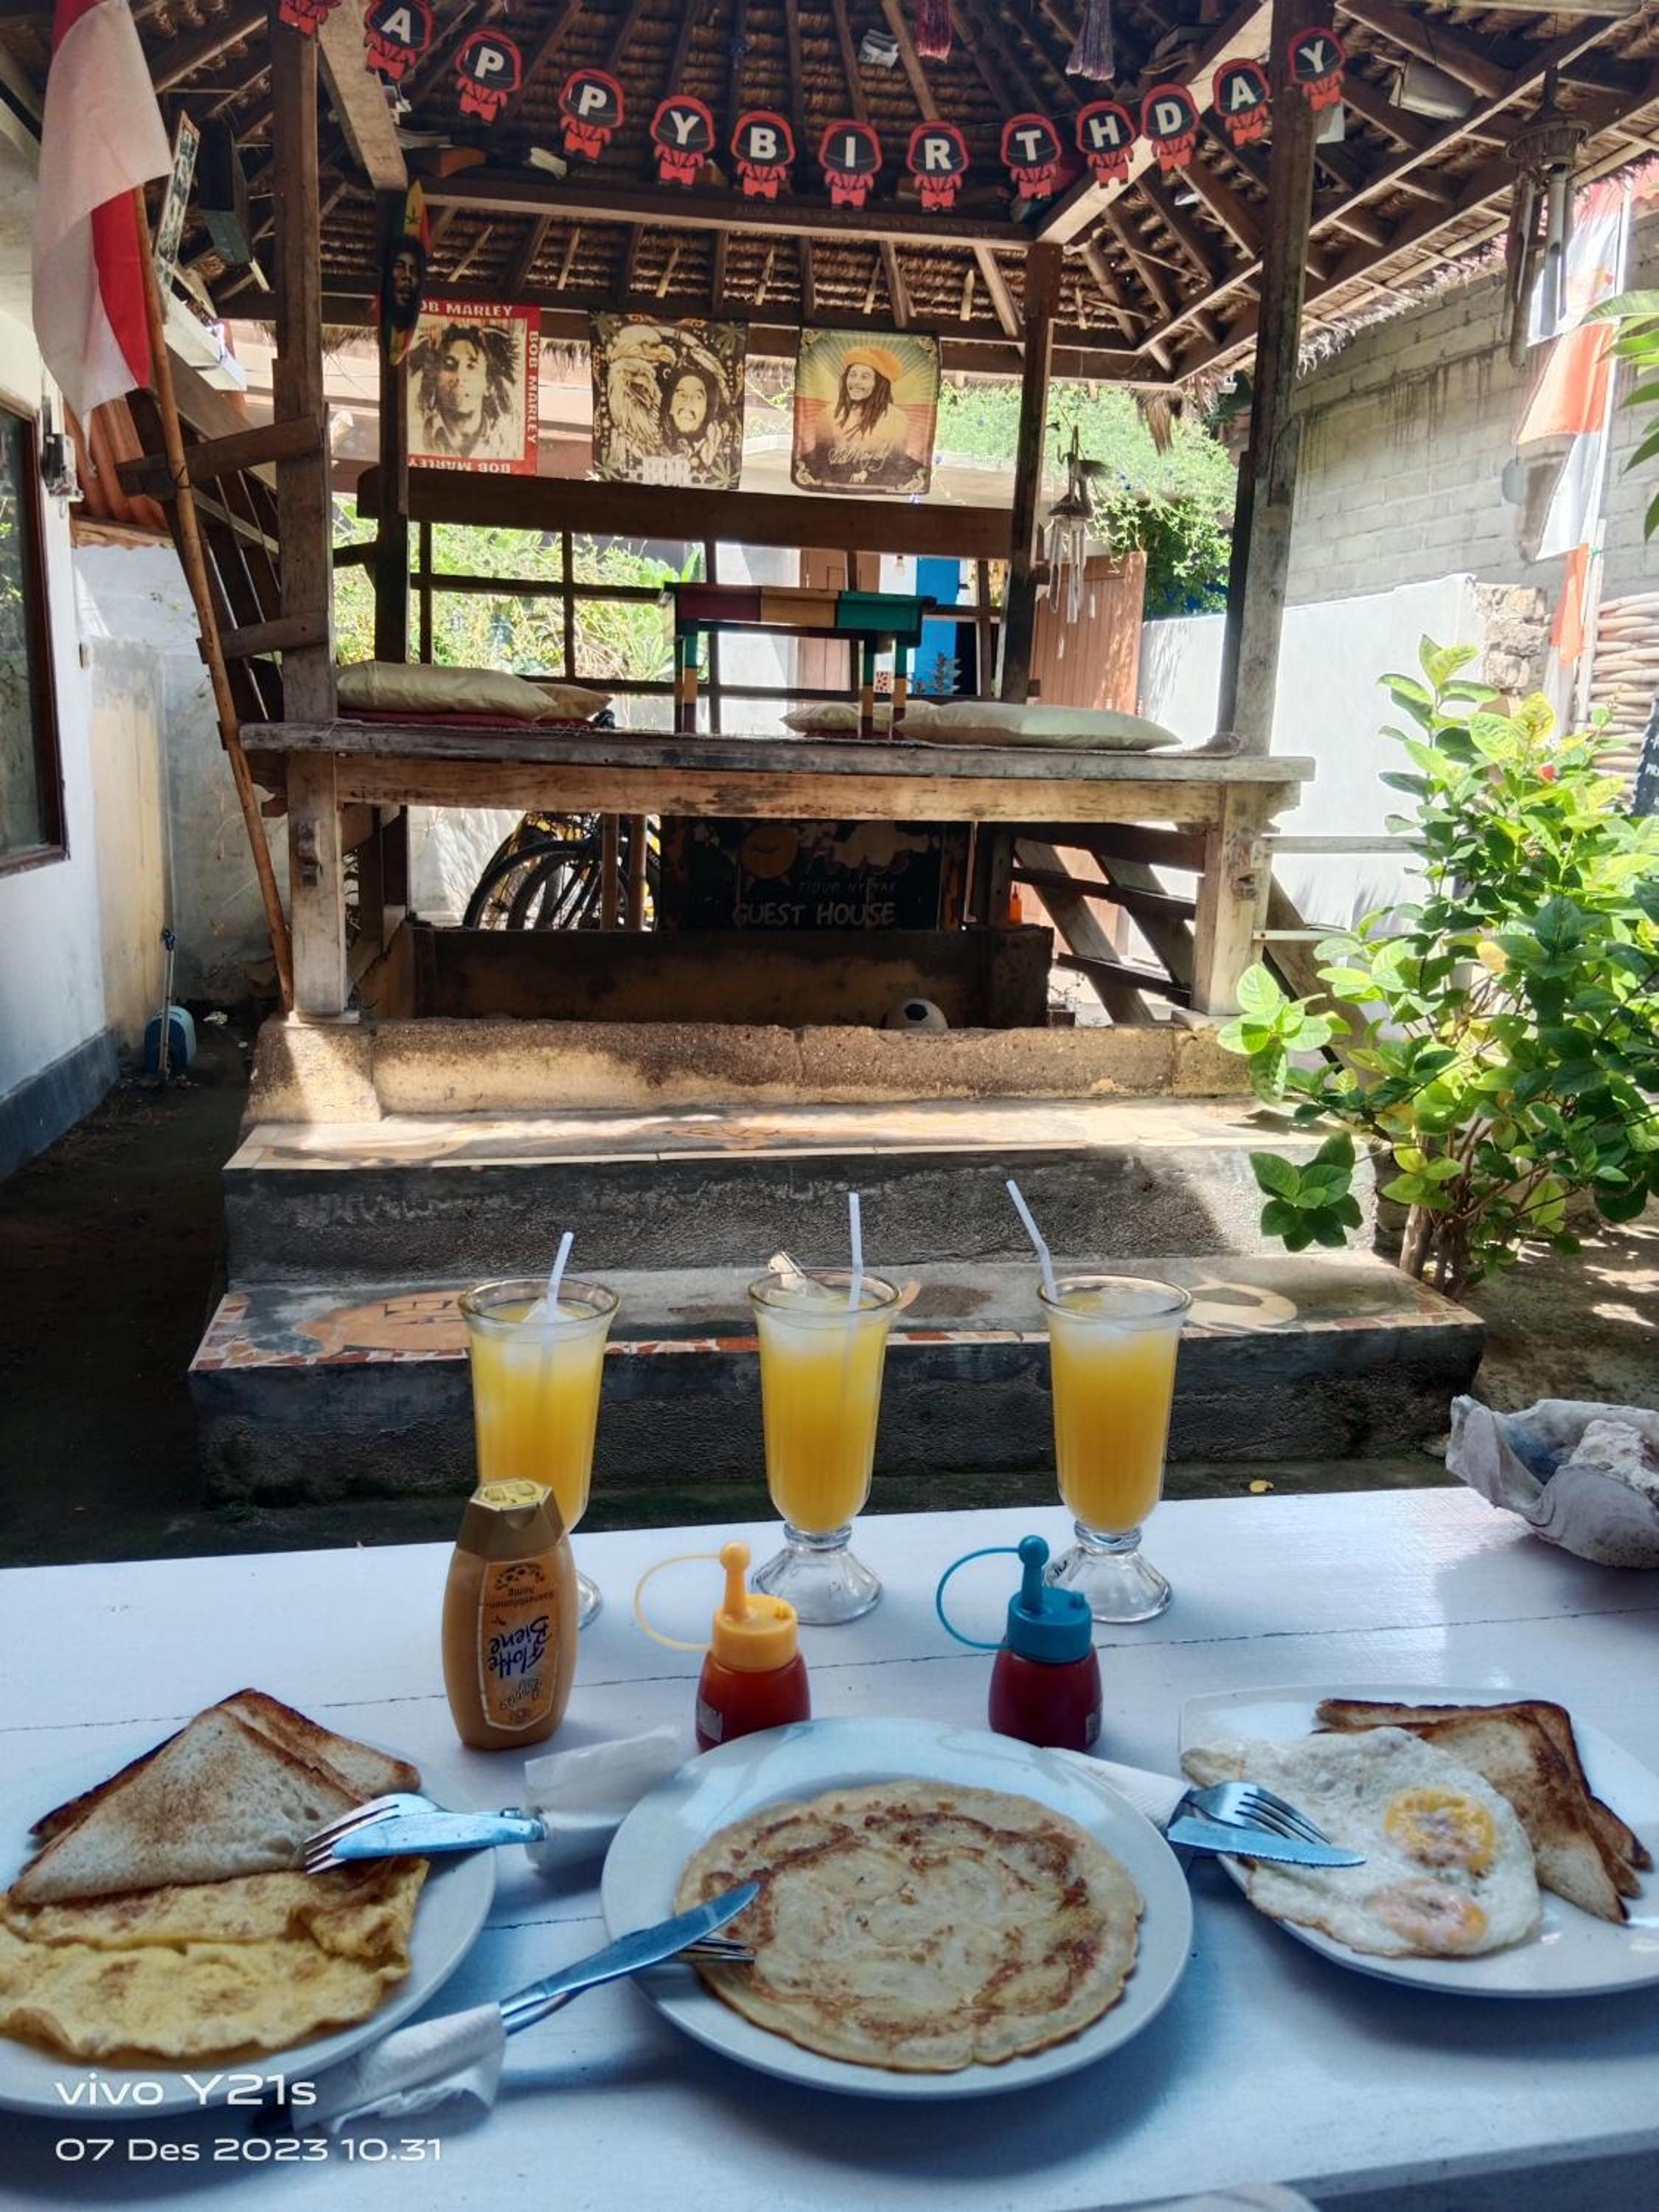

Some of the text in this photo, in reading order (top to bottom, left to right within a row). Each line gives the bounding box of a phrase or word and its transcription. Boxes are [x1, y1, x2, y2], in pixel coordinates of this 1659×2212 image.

[447, 304, 513, 316] MARLEY
[527, 330, 538, 444] BOB MARLEY
[408, 457, 512, 473] BOB MARLEY
[731, 901, 897, 927] GUEST HOUSE
[488, 1616, 550, 1654] Biene
[487, 1642, 544, 1679] Flotte
